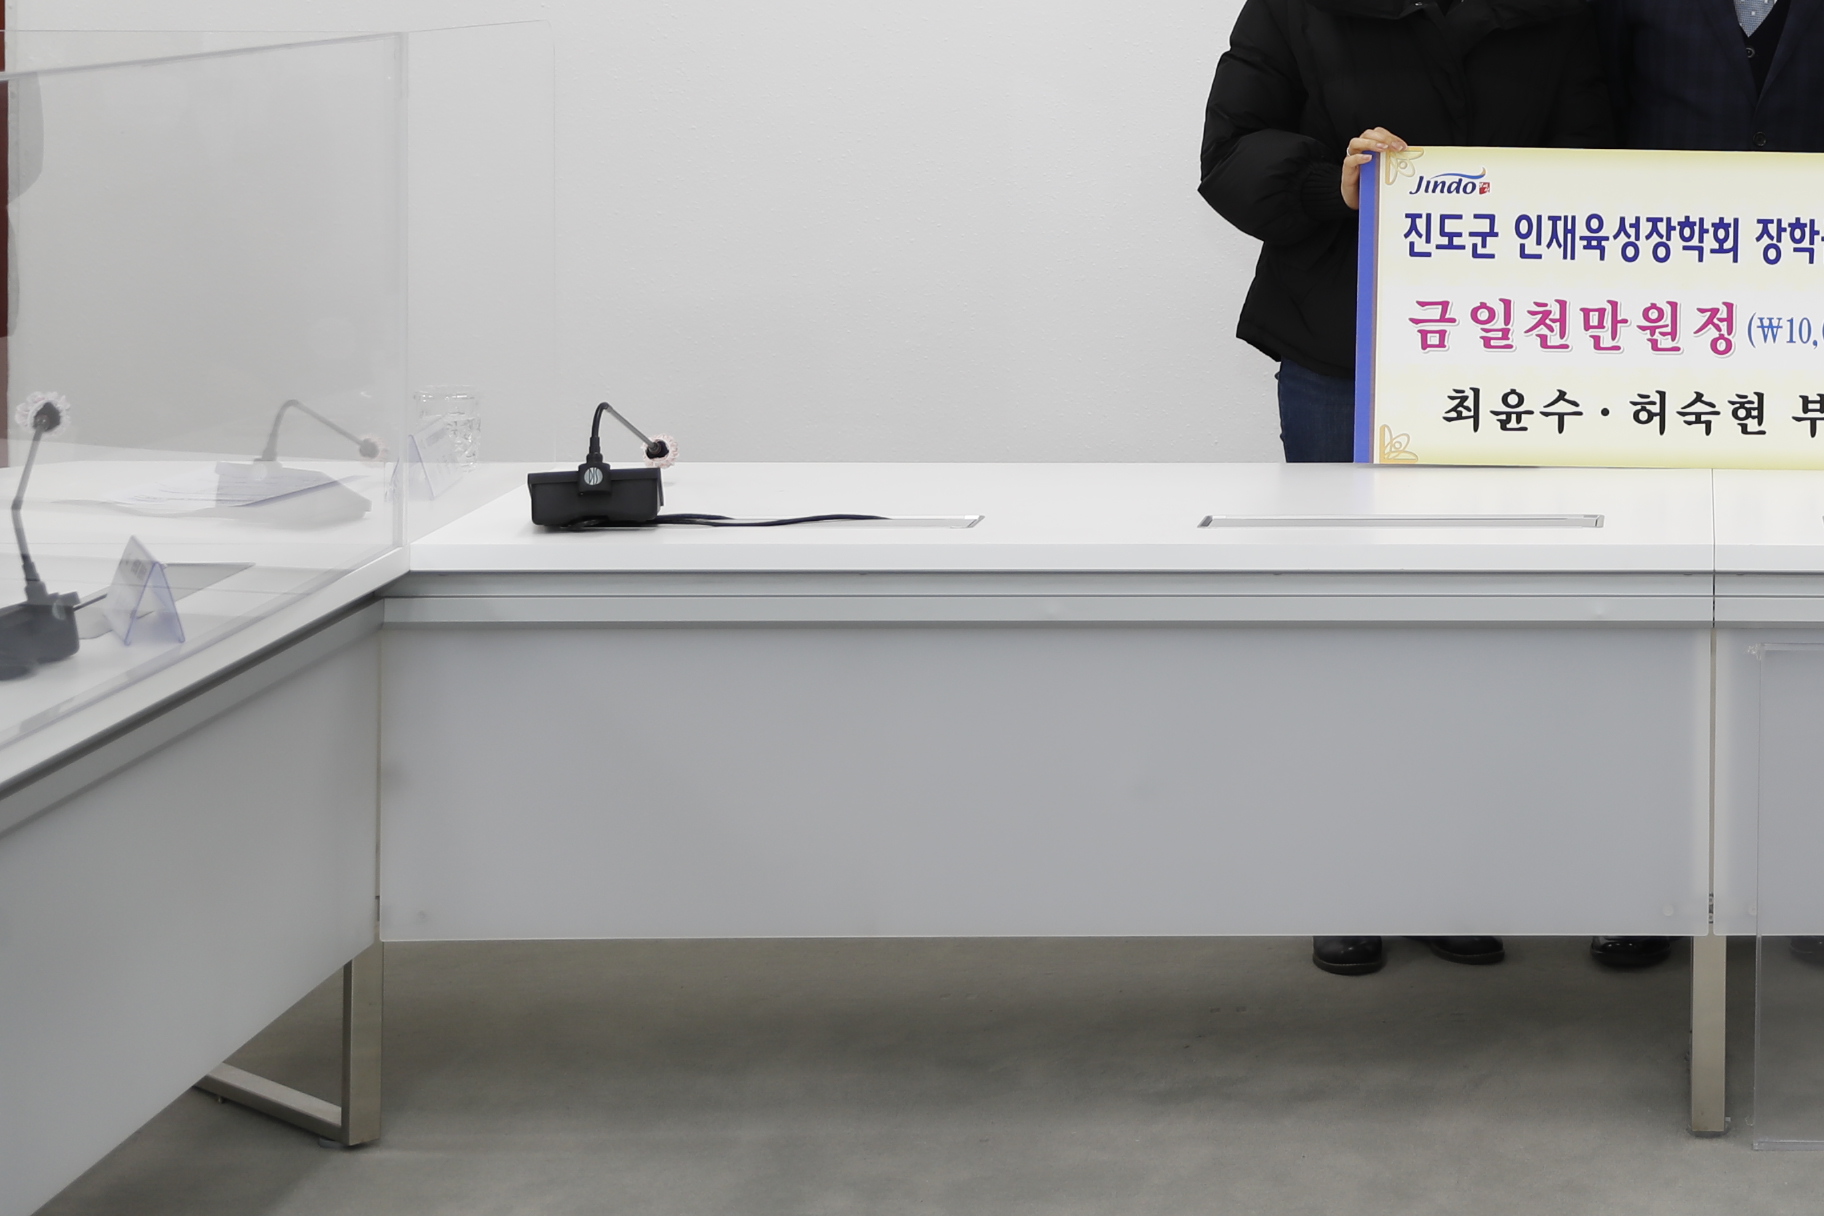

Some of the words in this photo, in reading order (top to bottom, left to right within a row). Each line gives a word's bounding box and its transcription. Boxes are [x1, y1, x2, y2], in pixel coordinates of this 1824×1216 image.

[1408, 175, 1477, 195] Jindo
[1403, 212, 1501, 261] 진도군
[1514, 213, 1741, 264] 인재육성장학회
[1408, 297, 1737, 357] 금일천만원정
